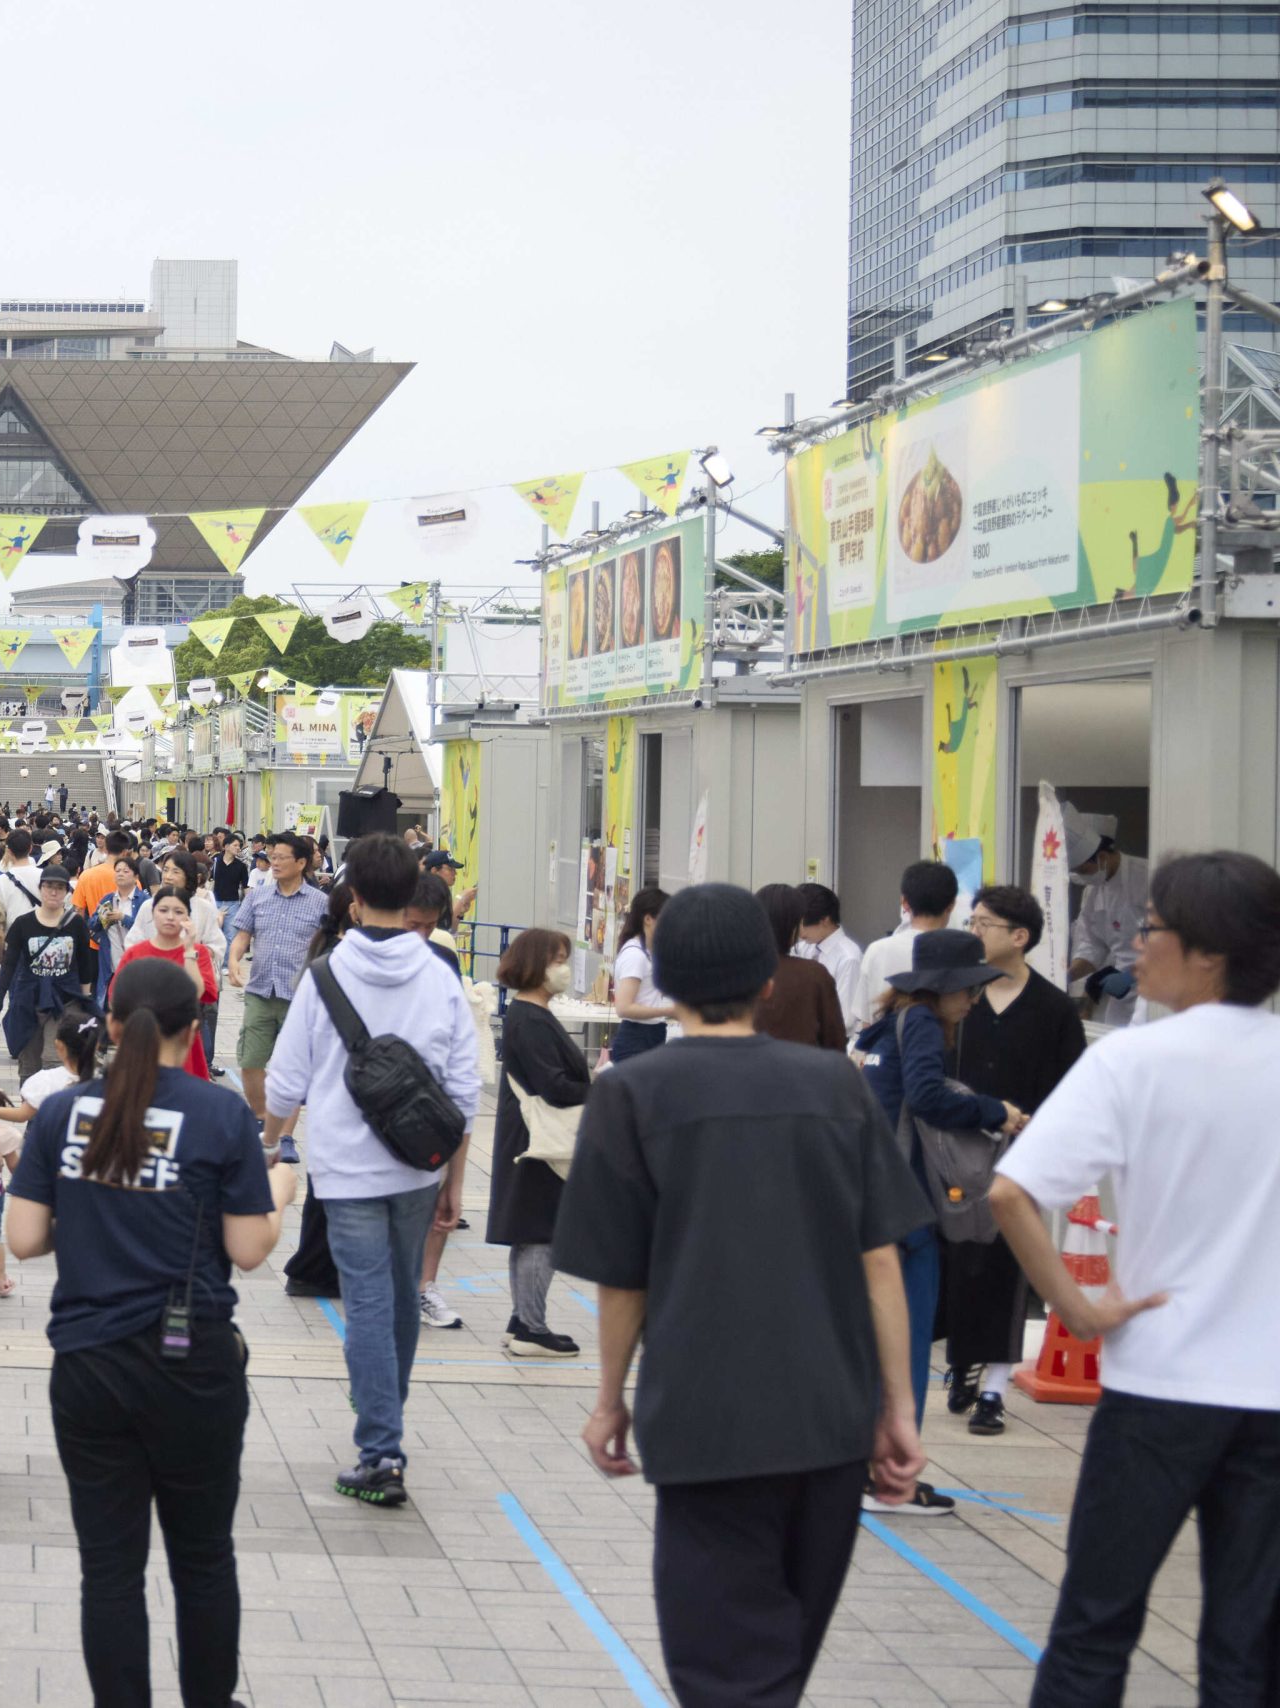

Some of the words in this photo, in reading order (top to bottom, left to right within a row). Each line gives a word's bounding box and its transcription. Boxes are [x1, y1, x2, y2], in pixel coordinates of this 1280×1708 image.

[32, 506, 88, 516] SIGHT
[830, 508, 874, 544] 東京山手調理師
[839, 540, 864, 567] 専門学校
[973, 542, 990, 560] ¥800
[291, 722, 305, 732] AL
[309, 723, 337, 732] MINA
[60, 1145, 180, 1191] SFF
